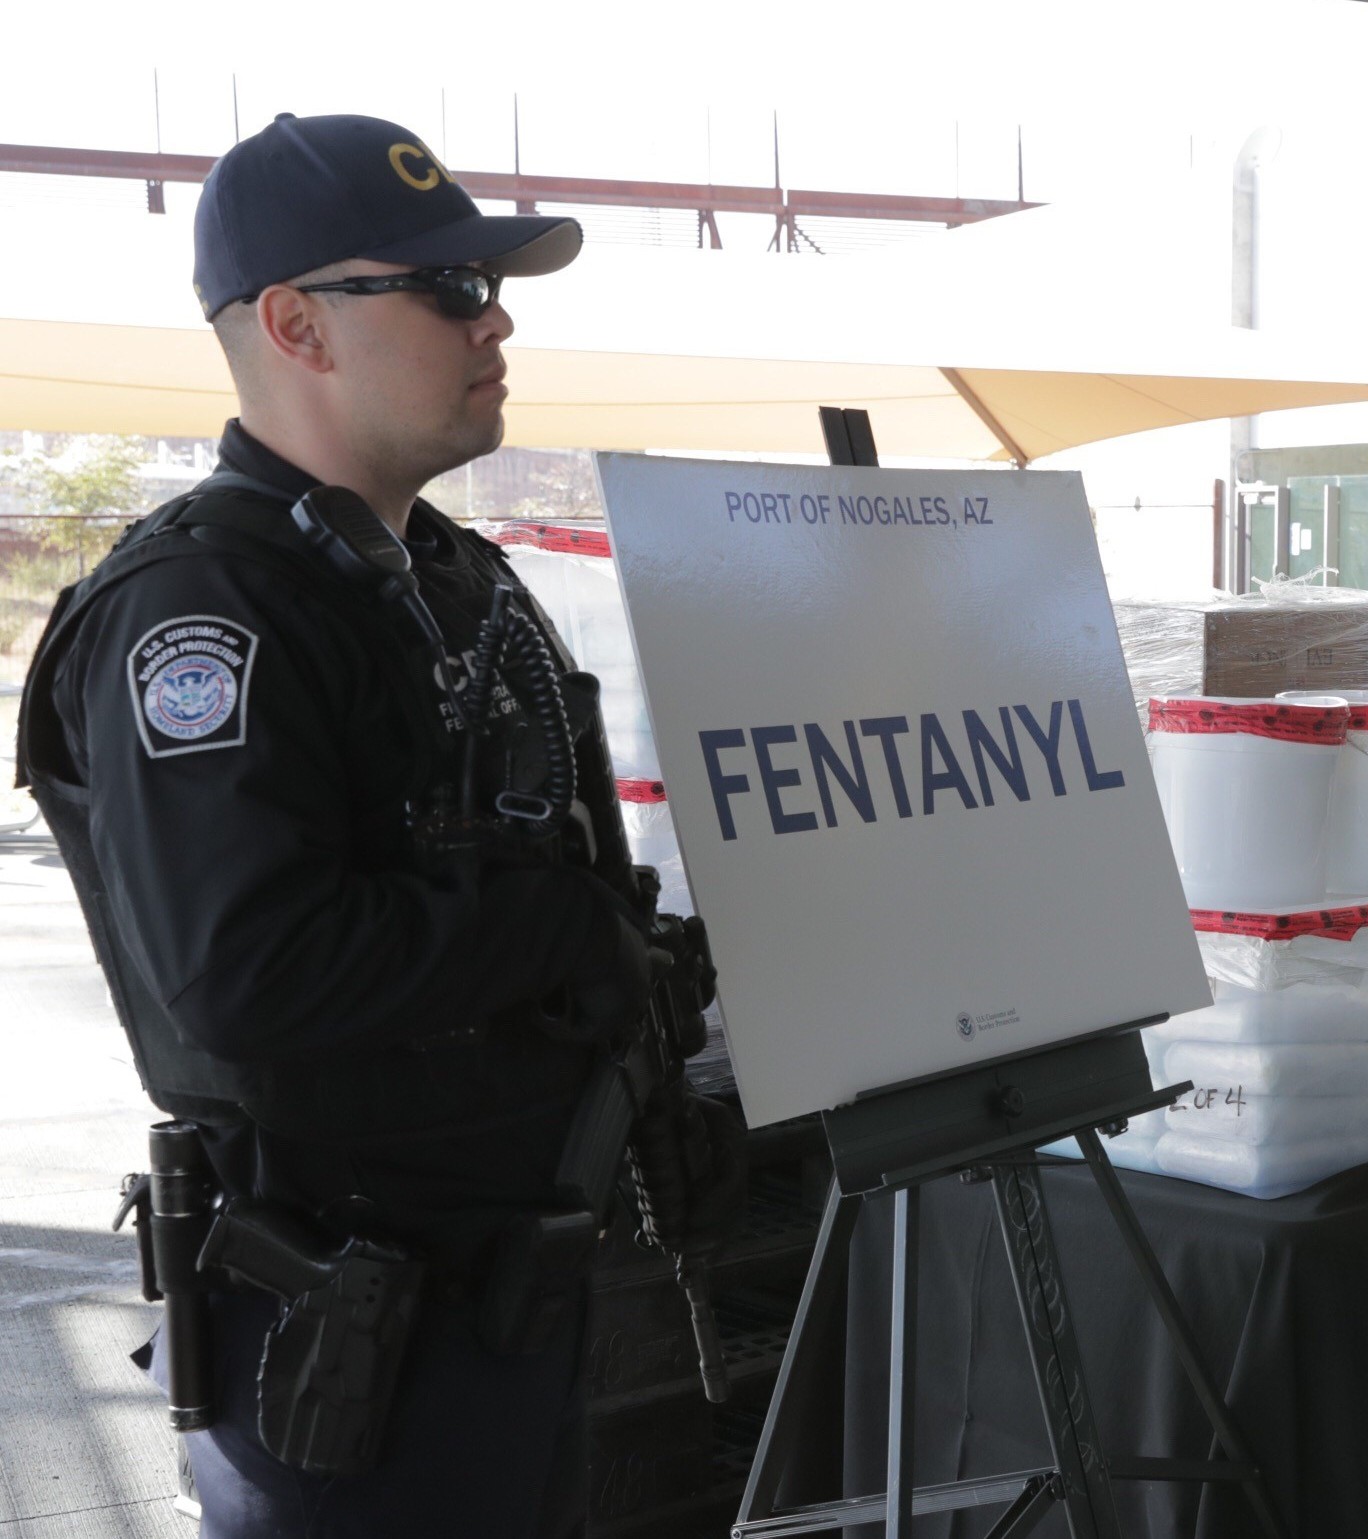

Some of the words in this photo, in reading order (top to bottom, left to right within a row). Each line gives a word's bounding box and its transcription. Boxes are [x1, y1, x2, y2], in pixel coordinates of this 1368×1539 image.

[725, 491, 792, 523] PORT
[800, 494, 831, 525] OF
[838, 495, 958, 529] NOGALES,
[964, 497, 994, 525] AZ
[164, 626, 223, 643] CUSTOMS
[138, 646, 179, 682] BORDER
[177, 640, 244, 667] PROTECTION
[698, 699, 1126, 841] FENTANYL
[1194, 1088, 1218, 1109] OF
[1225, 1084, 1247, 1117] 4
